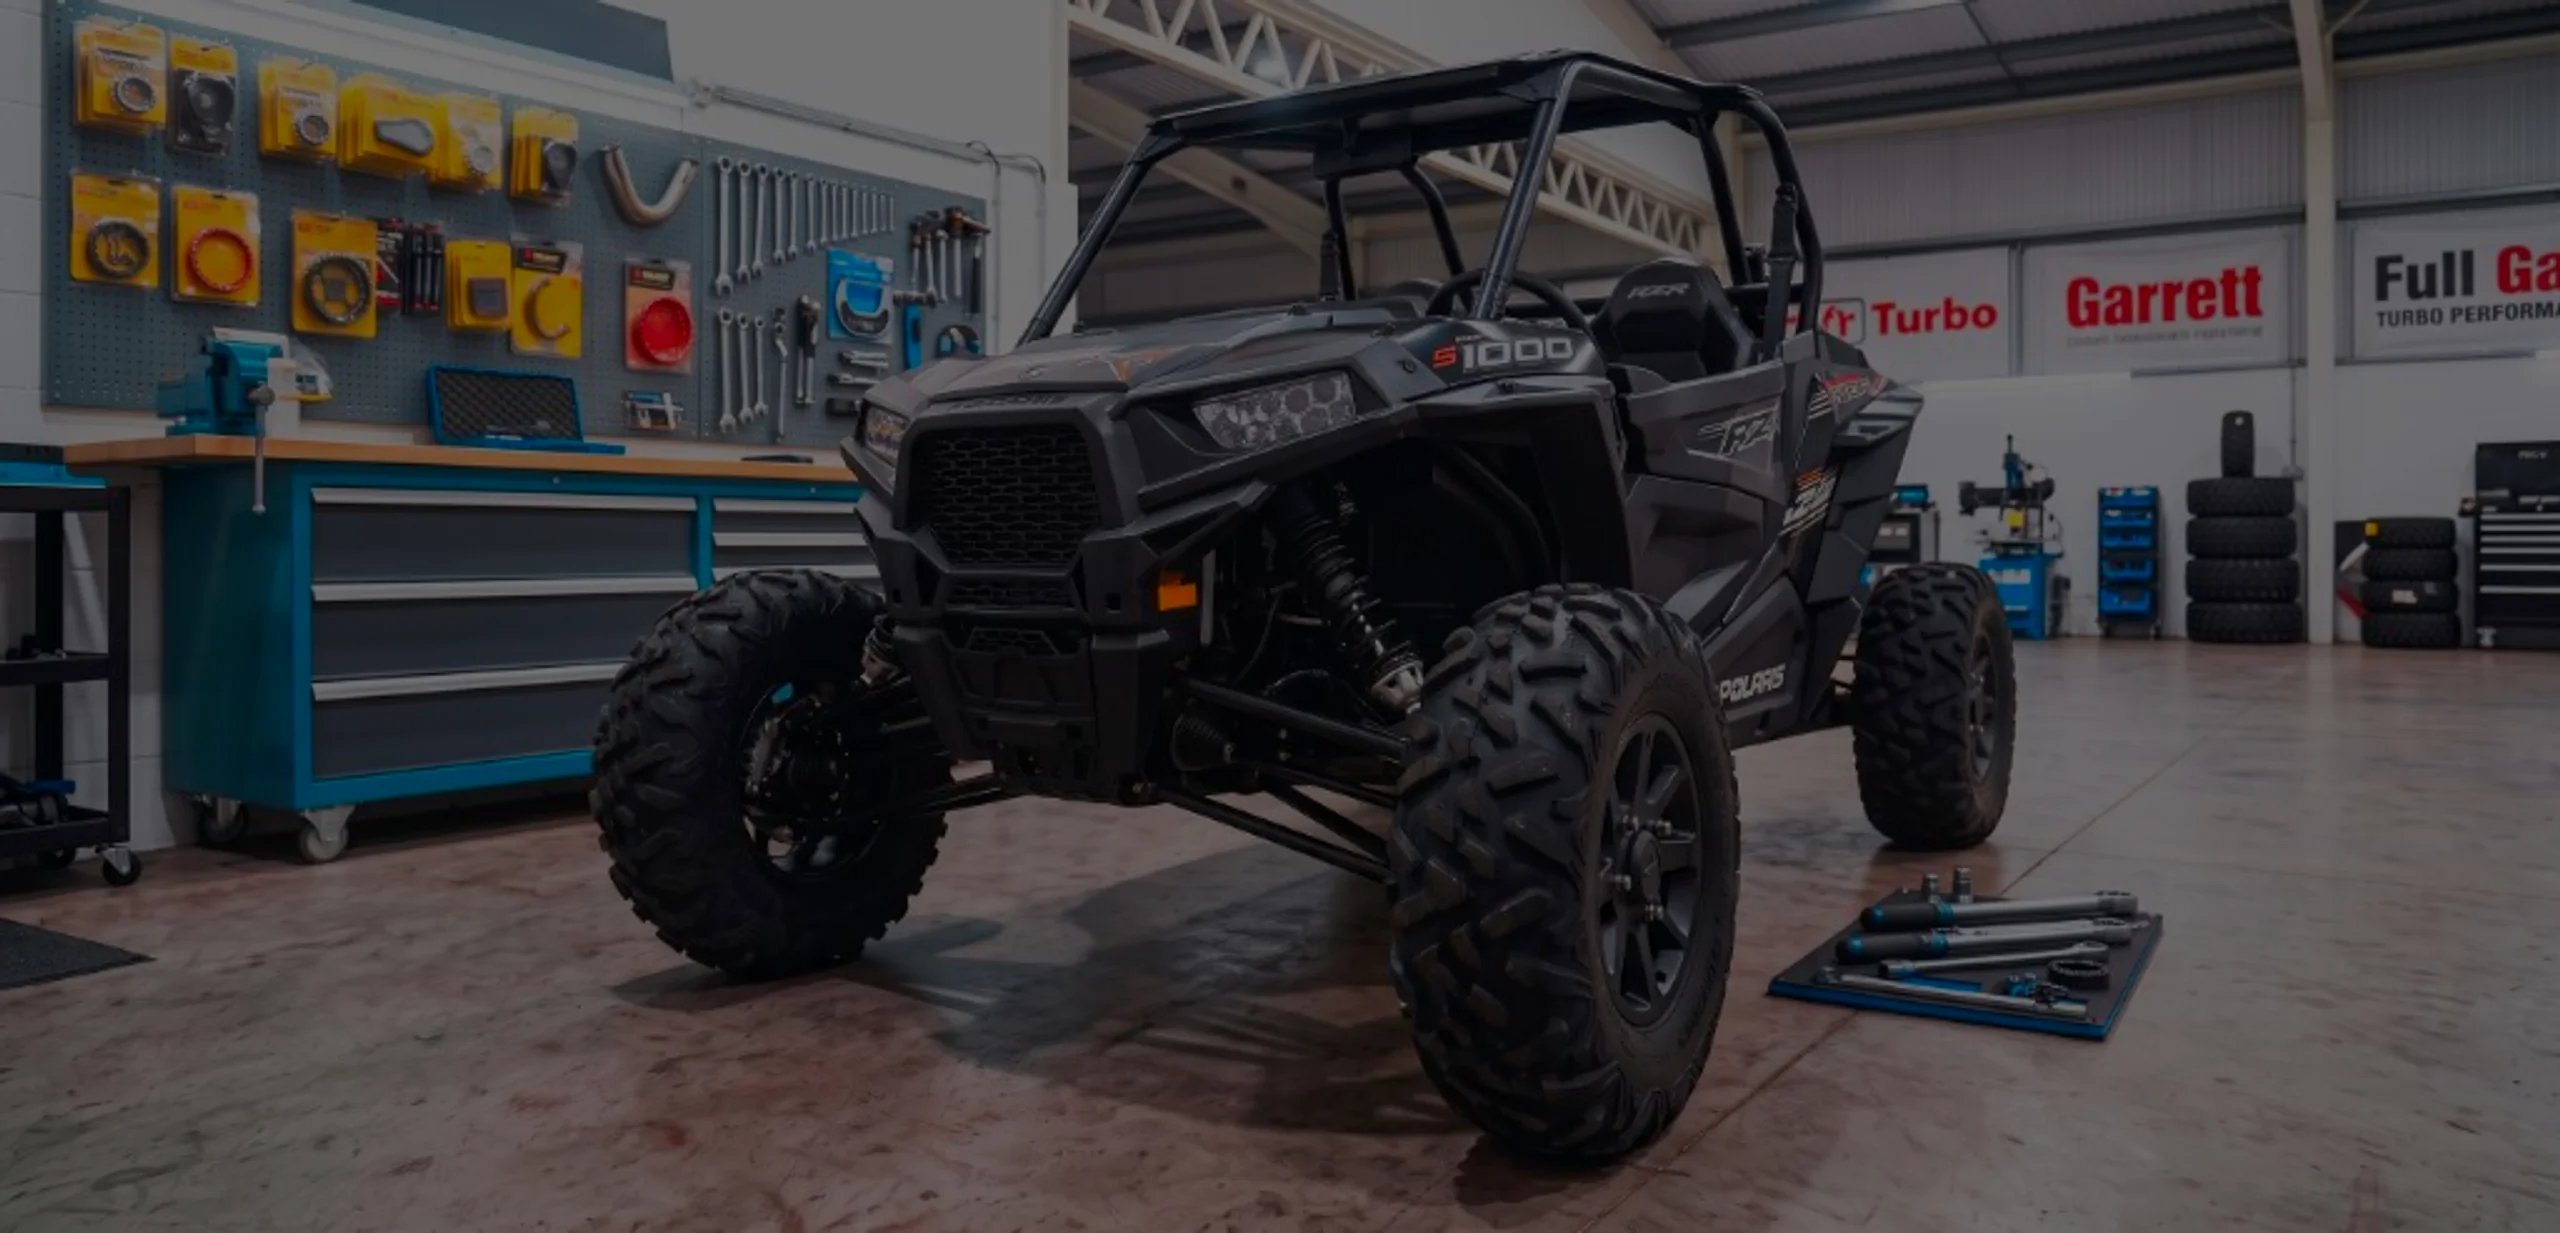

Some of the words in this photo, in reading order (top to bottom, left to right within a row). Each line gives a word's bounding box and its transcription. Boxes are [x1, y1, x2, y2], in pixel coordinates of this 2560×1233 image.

[2067, 267, 2262, 328] Garrett
[2376, 250, 2474, 301] Full
[1873, 297, 1997, 335] Turbo
[2377, 308, 2444, 328] TURBO
